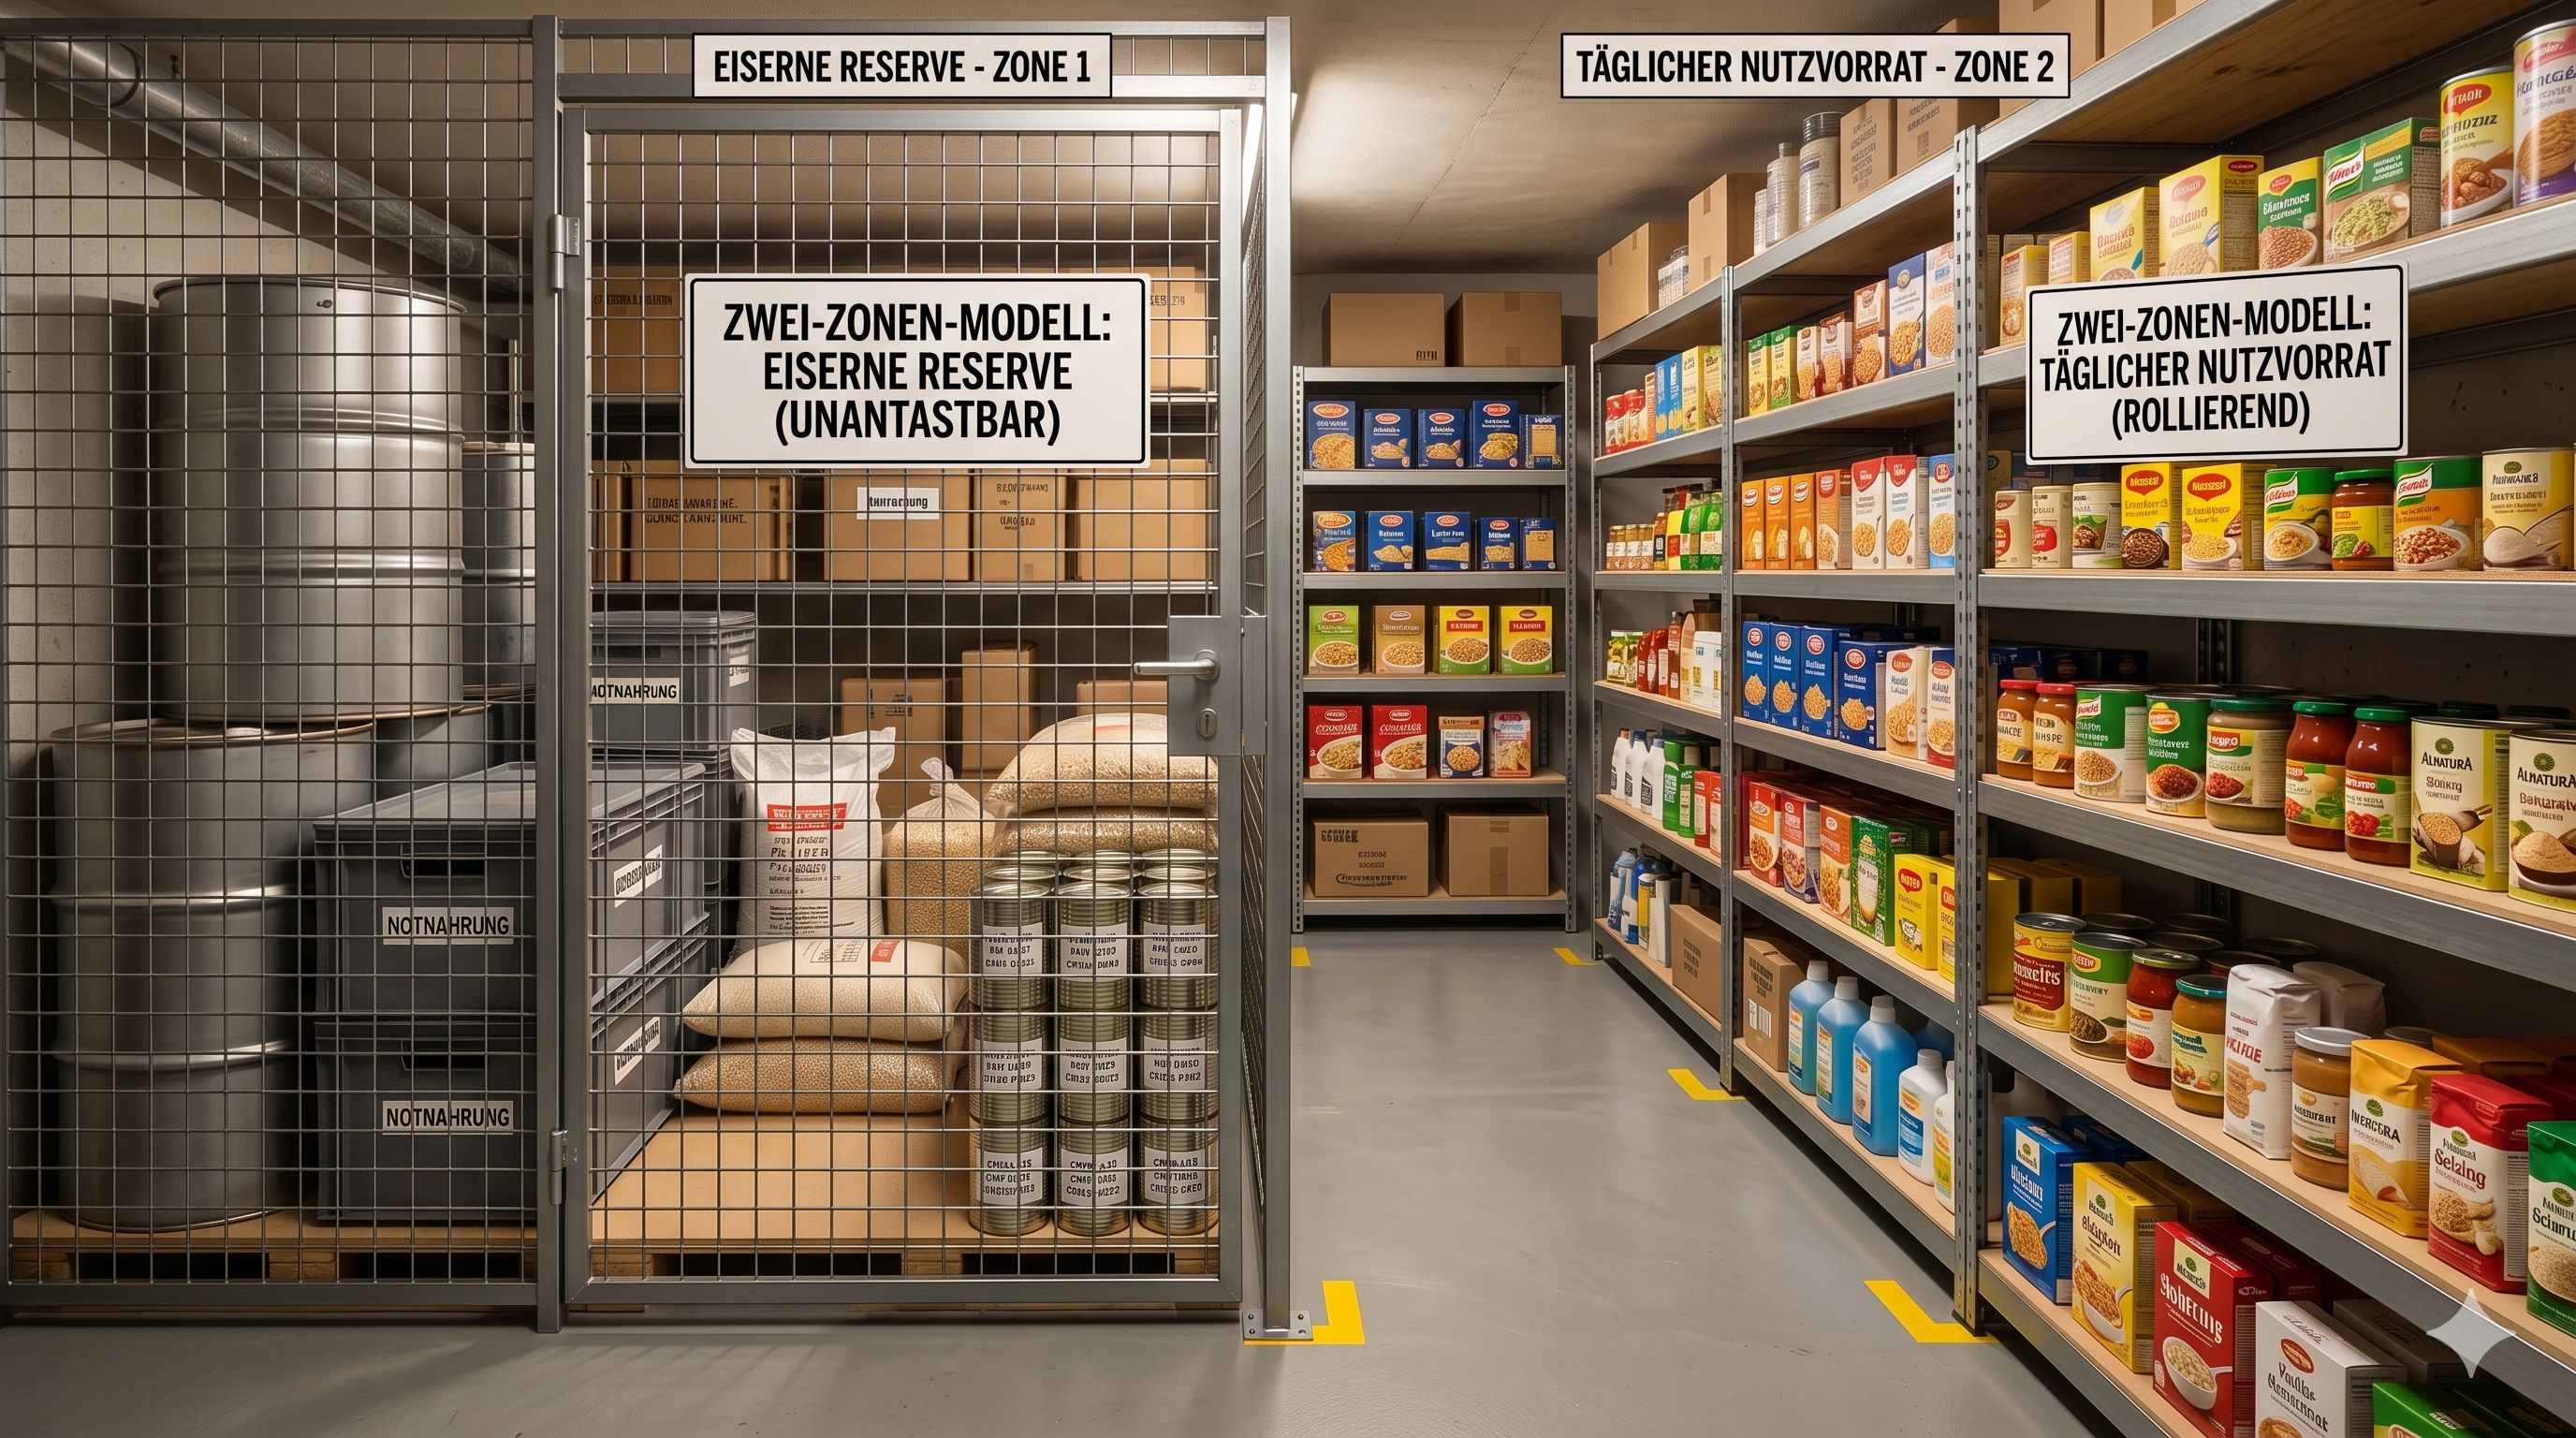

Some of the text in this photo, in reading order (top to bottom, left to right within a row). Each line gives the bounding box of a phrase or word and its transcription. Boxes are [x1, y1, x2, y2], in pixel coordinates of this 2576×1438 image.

[714, 50, 832, 83] EISERNE
[841, 50, 966, 83] RESERVE
[992, 50, 1068, 83] ZONE
[1076, 50, 1090, 82] 1
[1575, 43, 1733, 83] TÄGLICHER
[1741, 50, 1927, 83] NUTZVORRAT
[1954, 50, 2029, 83] ZONE
[2037, 50, 2054, 82] 2
[723, 302, 1111, 342] ZWEI-ZONEN-MODELL:
[2057, 294, 2371, 346] ZWEI-ZONEN-MODELL:
[764, 351, 1073, 390] EISERNE RESERVE
[2039, 340, 2392, 392] TÄGLICHER NUTZVORRAT
[775, 399, 1061, 447] (UNANTASTBAR)
[2112, 390, 2310, 441] (ROLLIEREND)
[2421, 752, 2473, 771] ALNATURA
[387, 916, 510, 936] NOTNAHRUNG
[386, 1107, 510, 1127] NOTNAHRUNG
